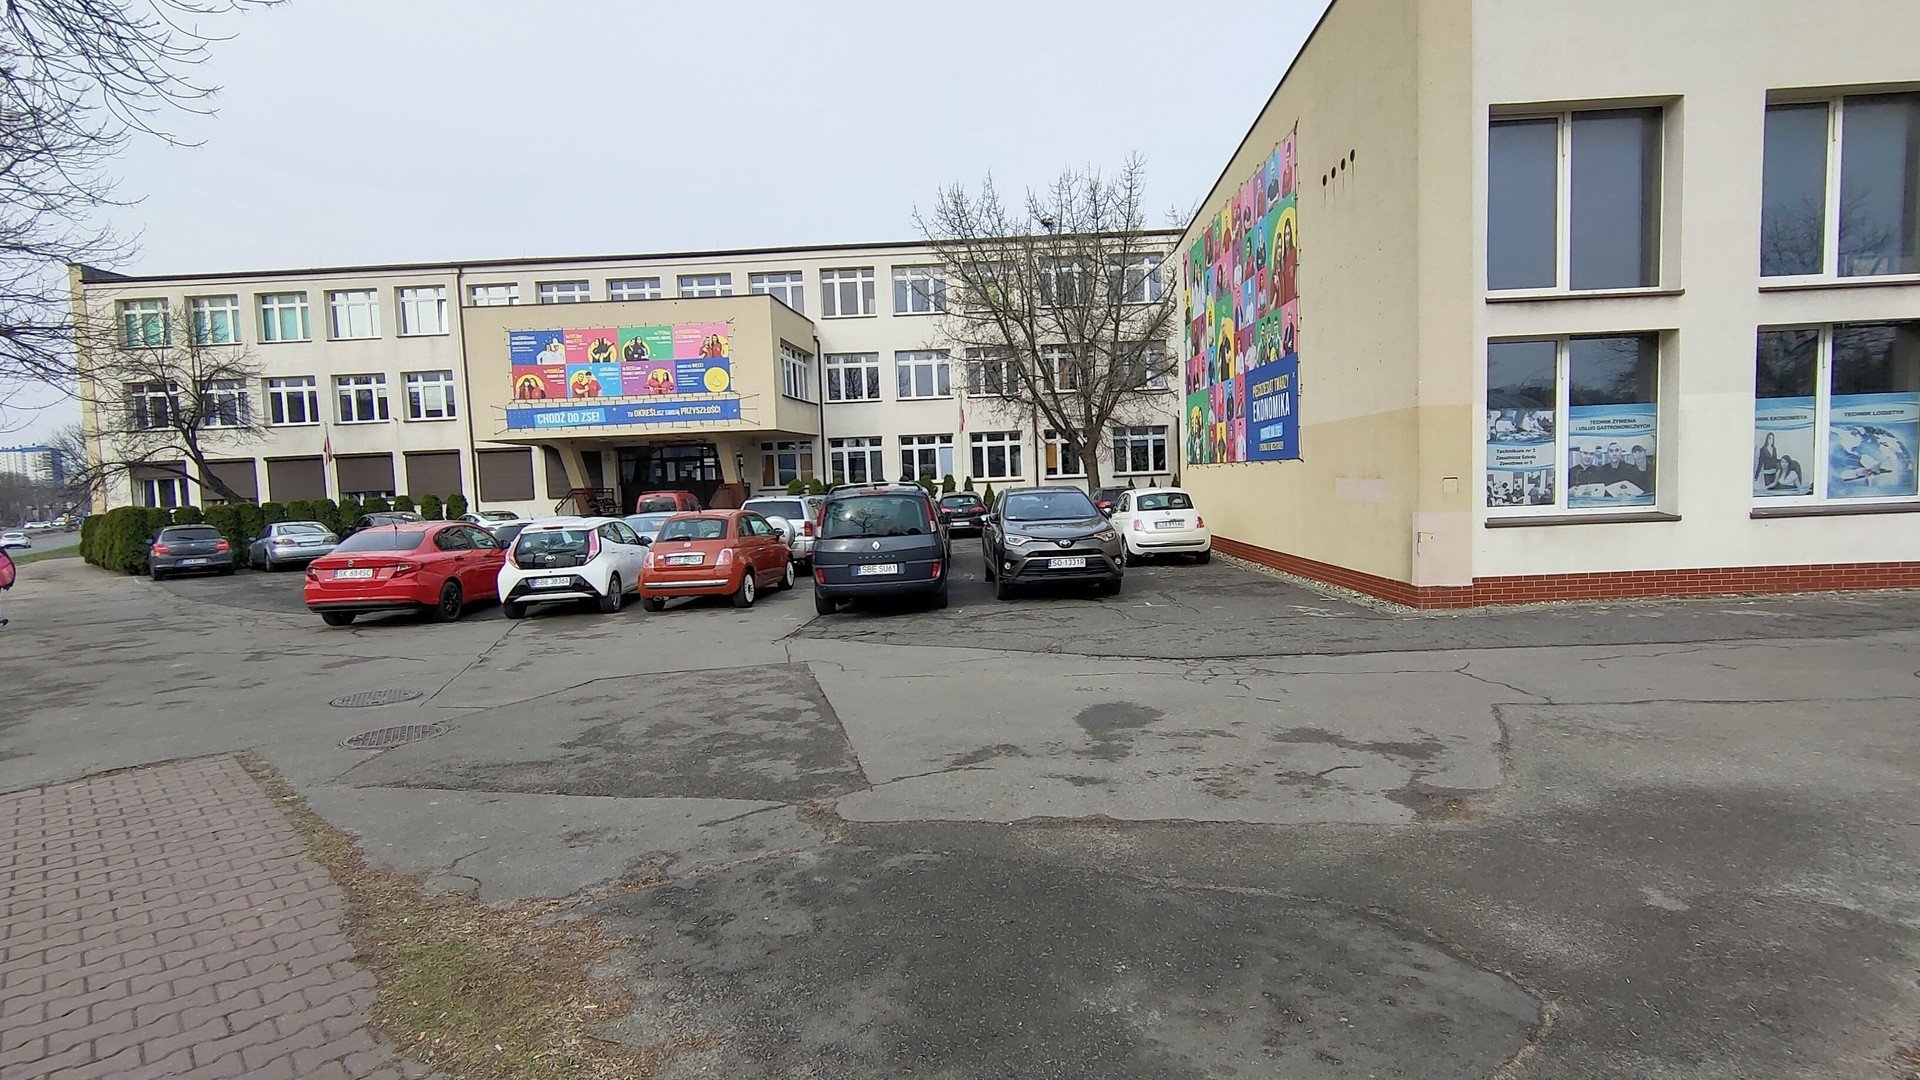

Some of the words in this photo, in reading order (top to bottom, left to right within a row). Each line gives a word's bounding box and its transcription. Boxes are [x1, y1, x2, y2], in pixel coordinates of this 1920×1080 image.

[1253, 392, 1290, 422] EKONOMIKA
[537, 411, 566, 424] CHODŹ
[567, 412, 580, 423] DO
[862, 565, 878, 574] SBE
